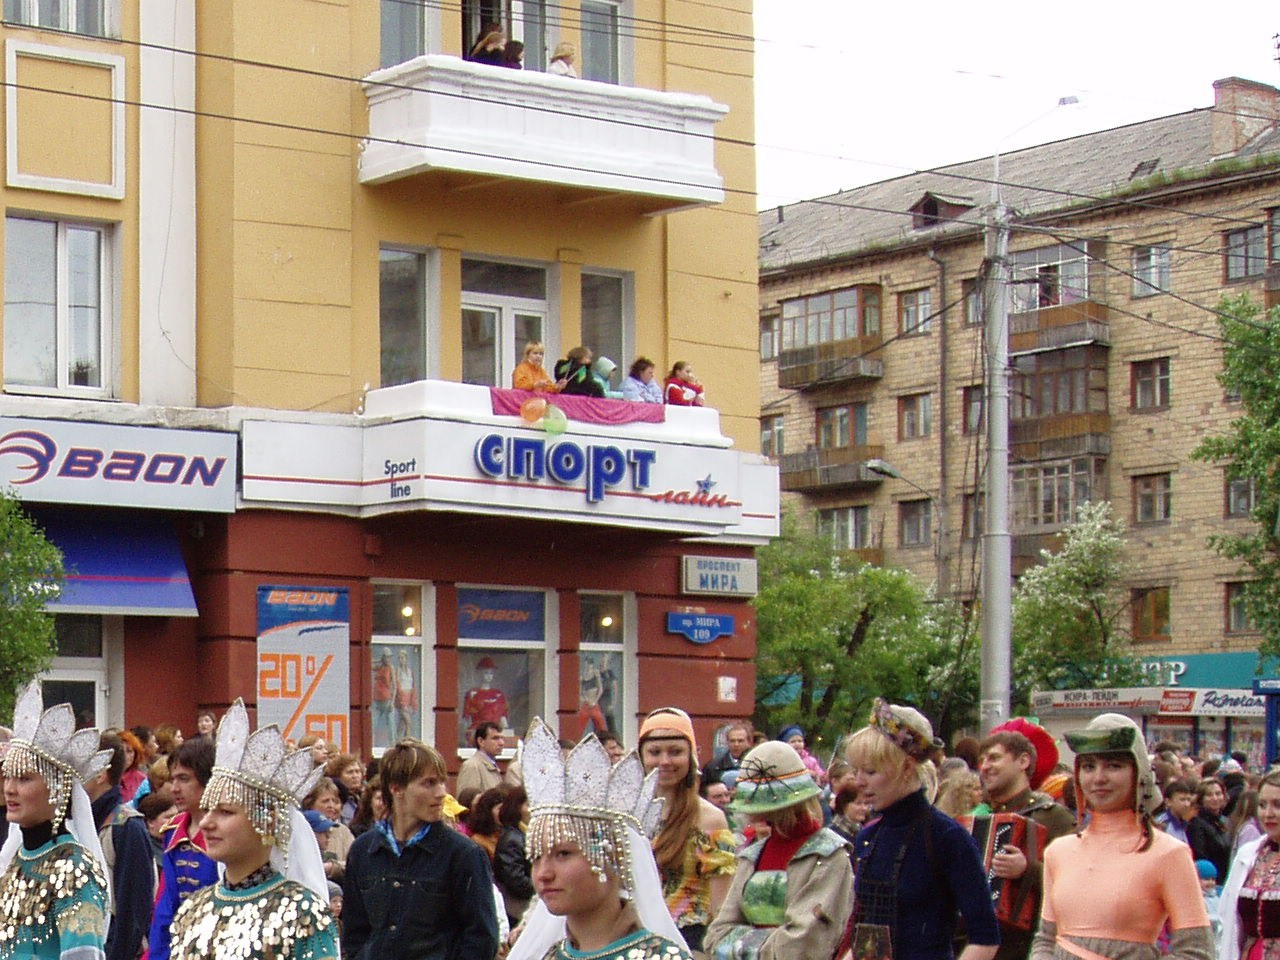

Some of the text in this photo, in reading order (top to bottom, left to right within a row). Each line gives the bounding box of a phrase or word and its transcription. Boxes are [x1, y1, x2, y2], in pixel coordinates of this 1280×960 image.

[384, 458, 416, 478] Sport
[391, 483, 411, 498] line
[697, 560, 741, 571] ПРОСПЕКТ
[700, 573, 738, 590] МИРА
[696, 617, 721, 627] МИРА
[693, 629, 710, 639] 109
